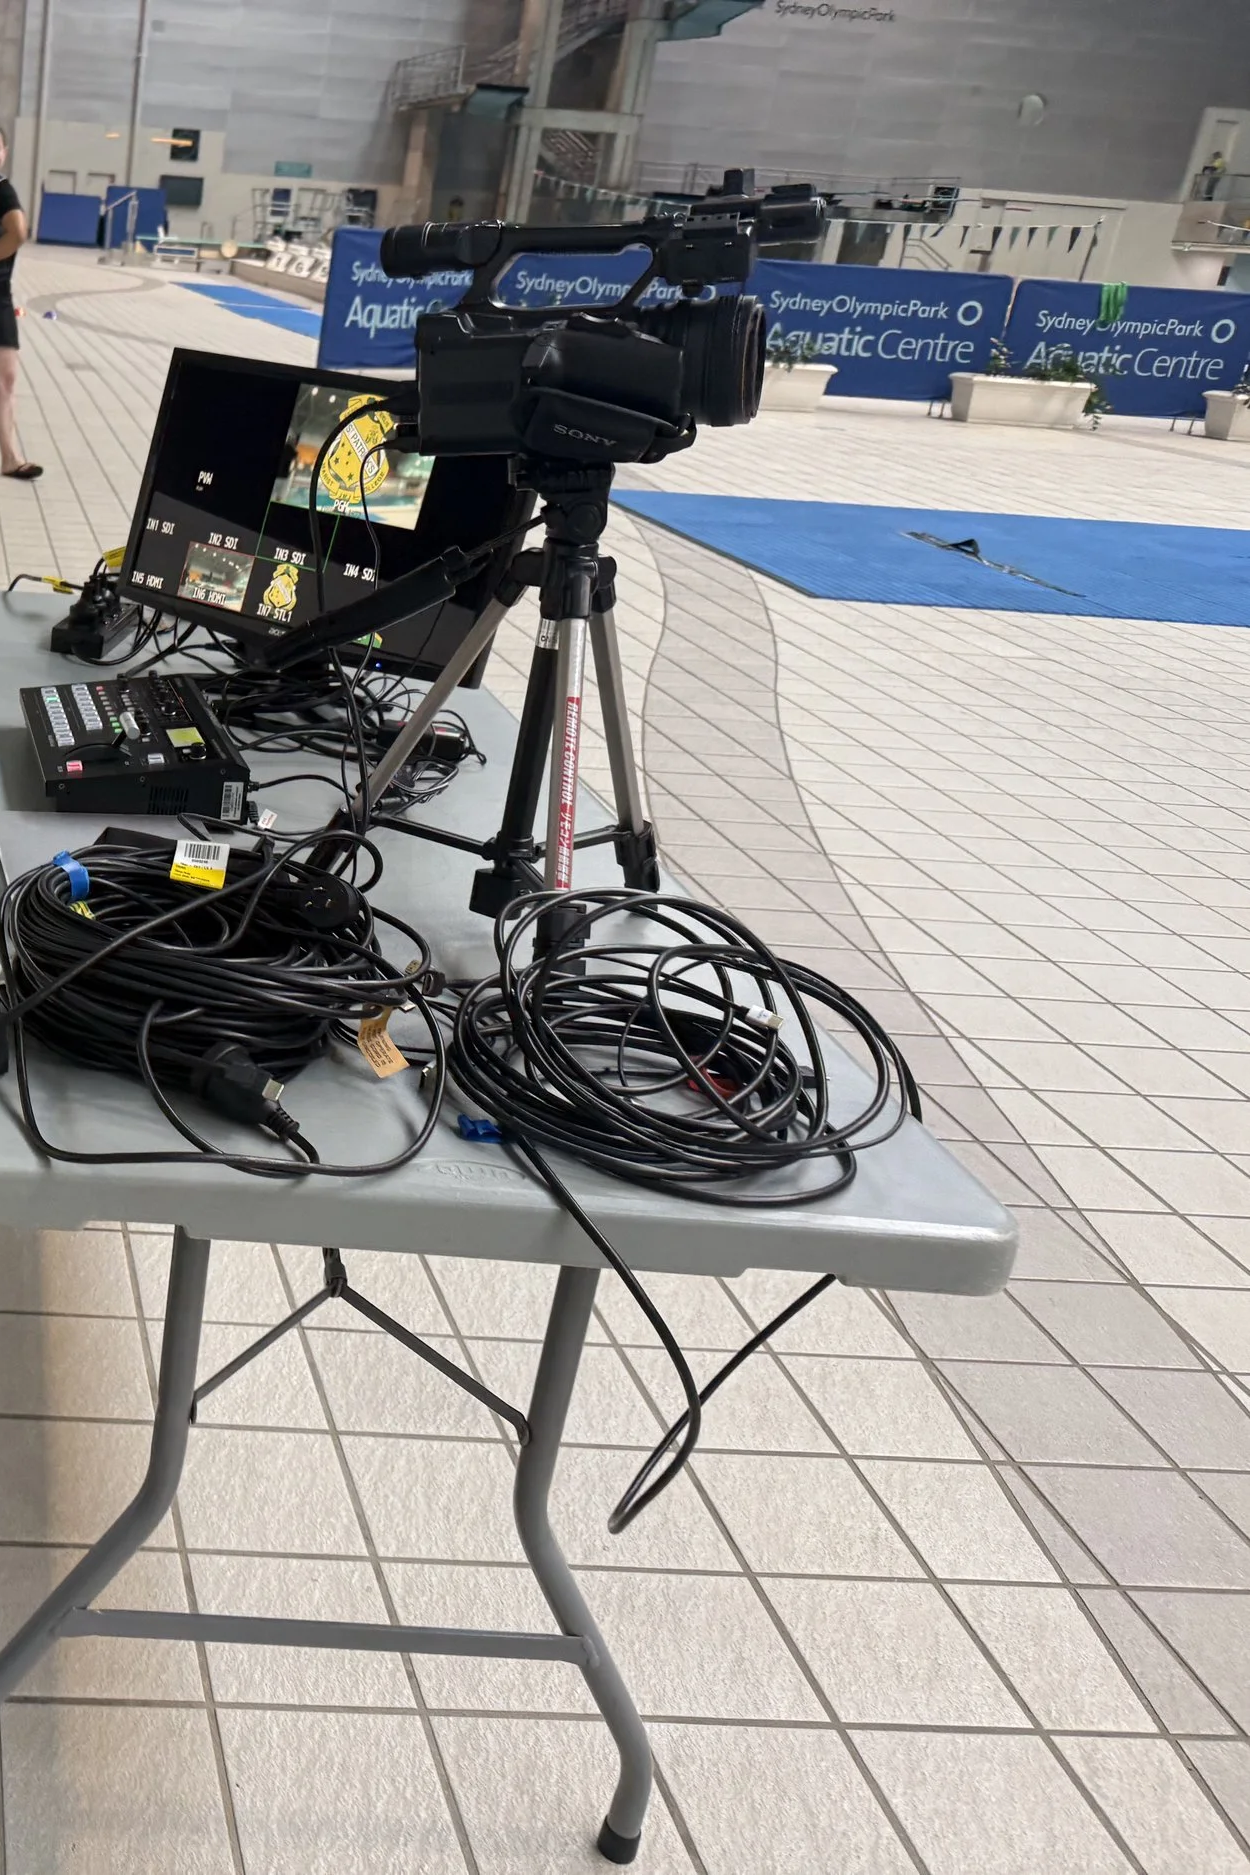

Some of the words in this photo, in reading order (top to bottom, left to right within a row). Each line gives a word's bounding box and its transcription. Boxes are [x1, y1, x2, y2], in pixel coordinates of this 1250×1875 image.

[775, 0, 895, 21] SydneyOlympicPark
[770, 290, 949, 320] SydneyOlympicPark
[878, 329, 974, 363] Centre
[1134, 348, 1224, 380] Centre
[553, 423, 617, 446] SONY
[161, 520, 174, 535] SDI
[208, 532, 222, 546] IN2
[224, 535, 239, 550] SDI
[274, 547, 289, 561] IN3
[291, 550, 306, 566] SDI
[131, 571, 145, 585] IN5
[147, 574, 164, 590] HDMI
[343, 562, 360, 578] IN4
[192, 587, 206, 600] IN6
[208, 590, 226, 605] HDMI
[564, 701, 579, 749] REMOTE
[560, 750, 576, 807] CONTROL
